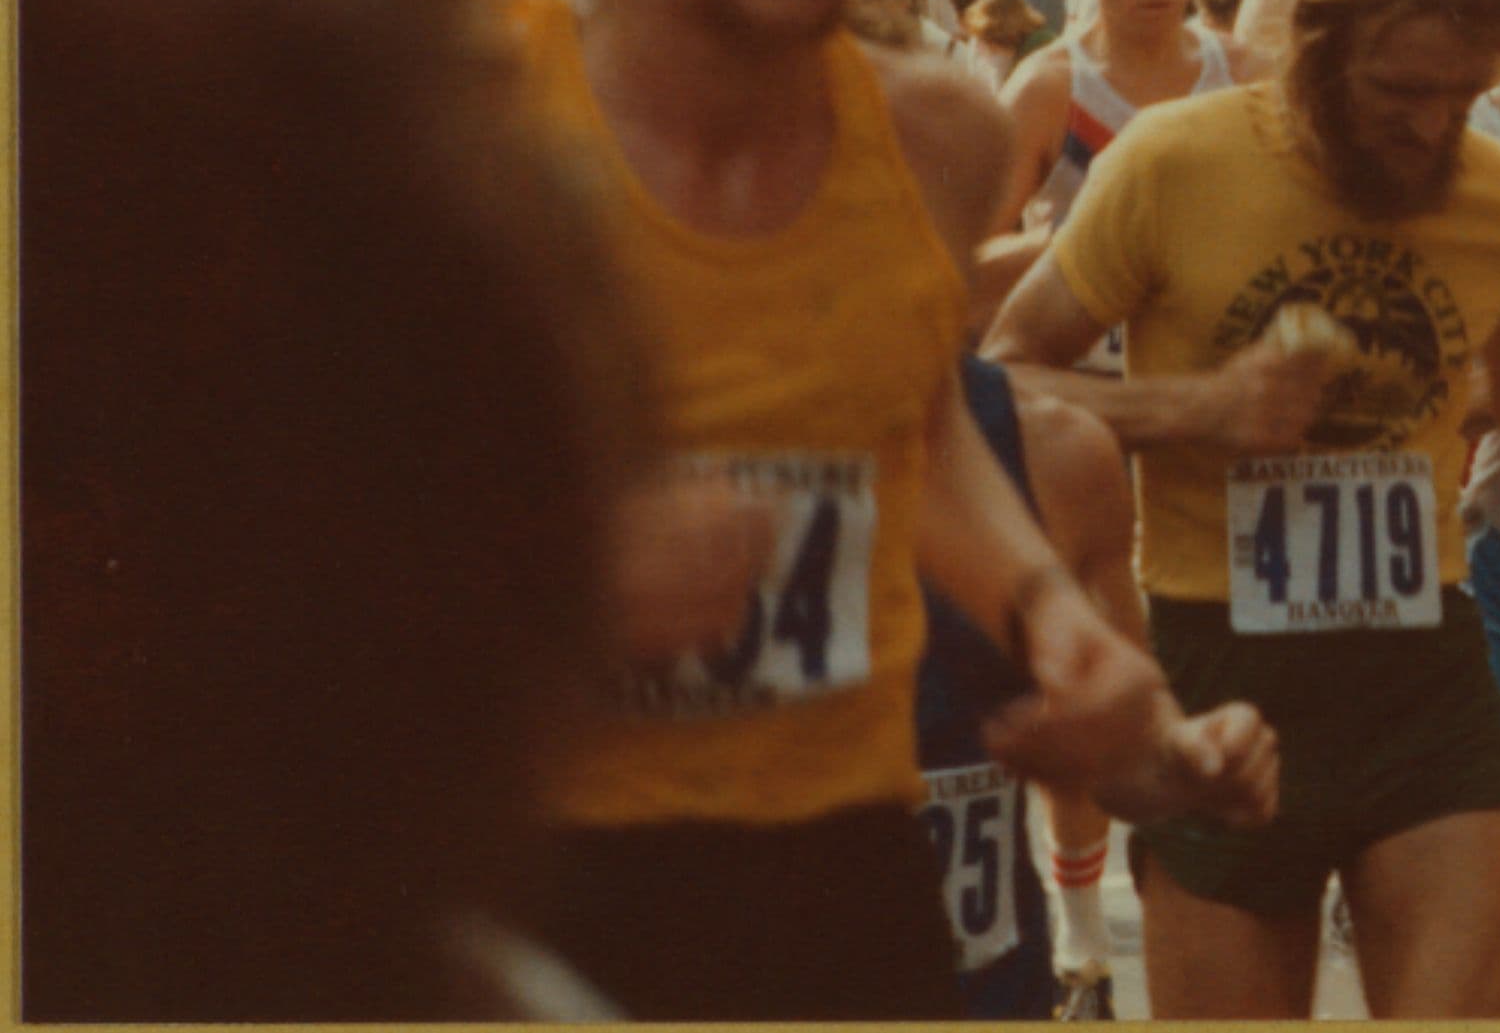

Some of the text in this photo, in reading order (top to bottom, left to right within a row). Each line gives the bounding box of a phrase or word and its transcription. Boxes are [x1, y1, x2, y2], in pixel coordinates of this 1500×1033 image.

[1298, 233, 1420, 282] YORK
[1422, 276, 1468, 367] CITY
[1253, 480, 1425, 605] 4719
